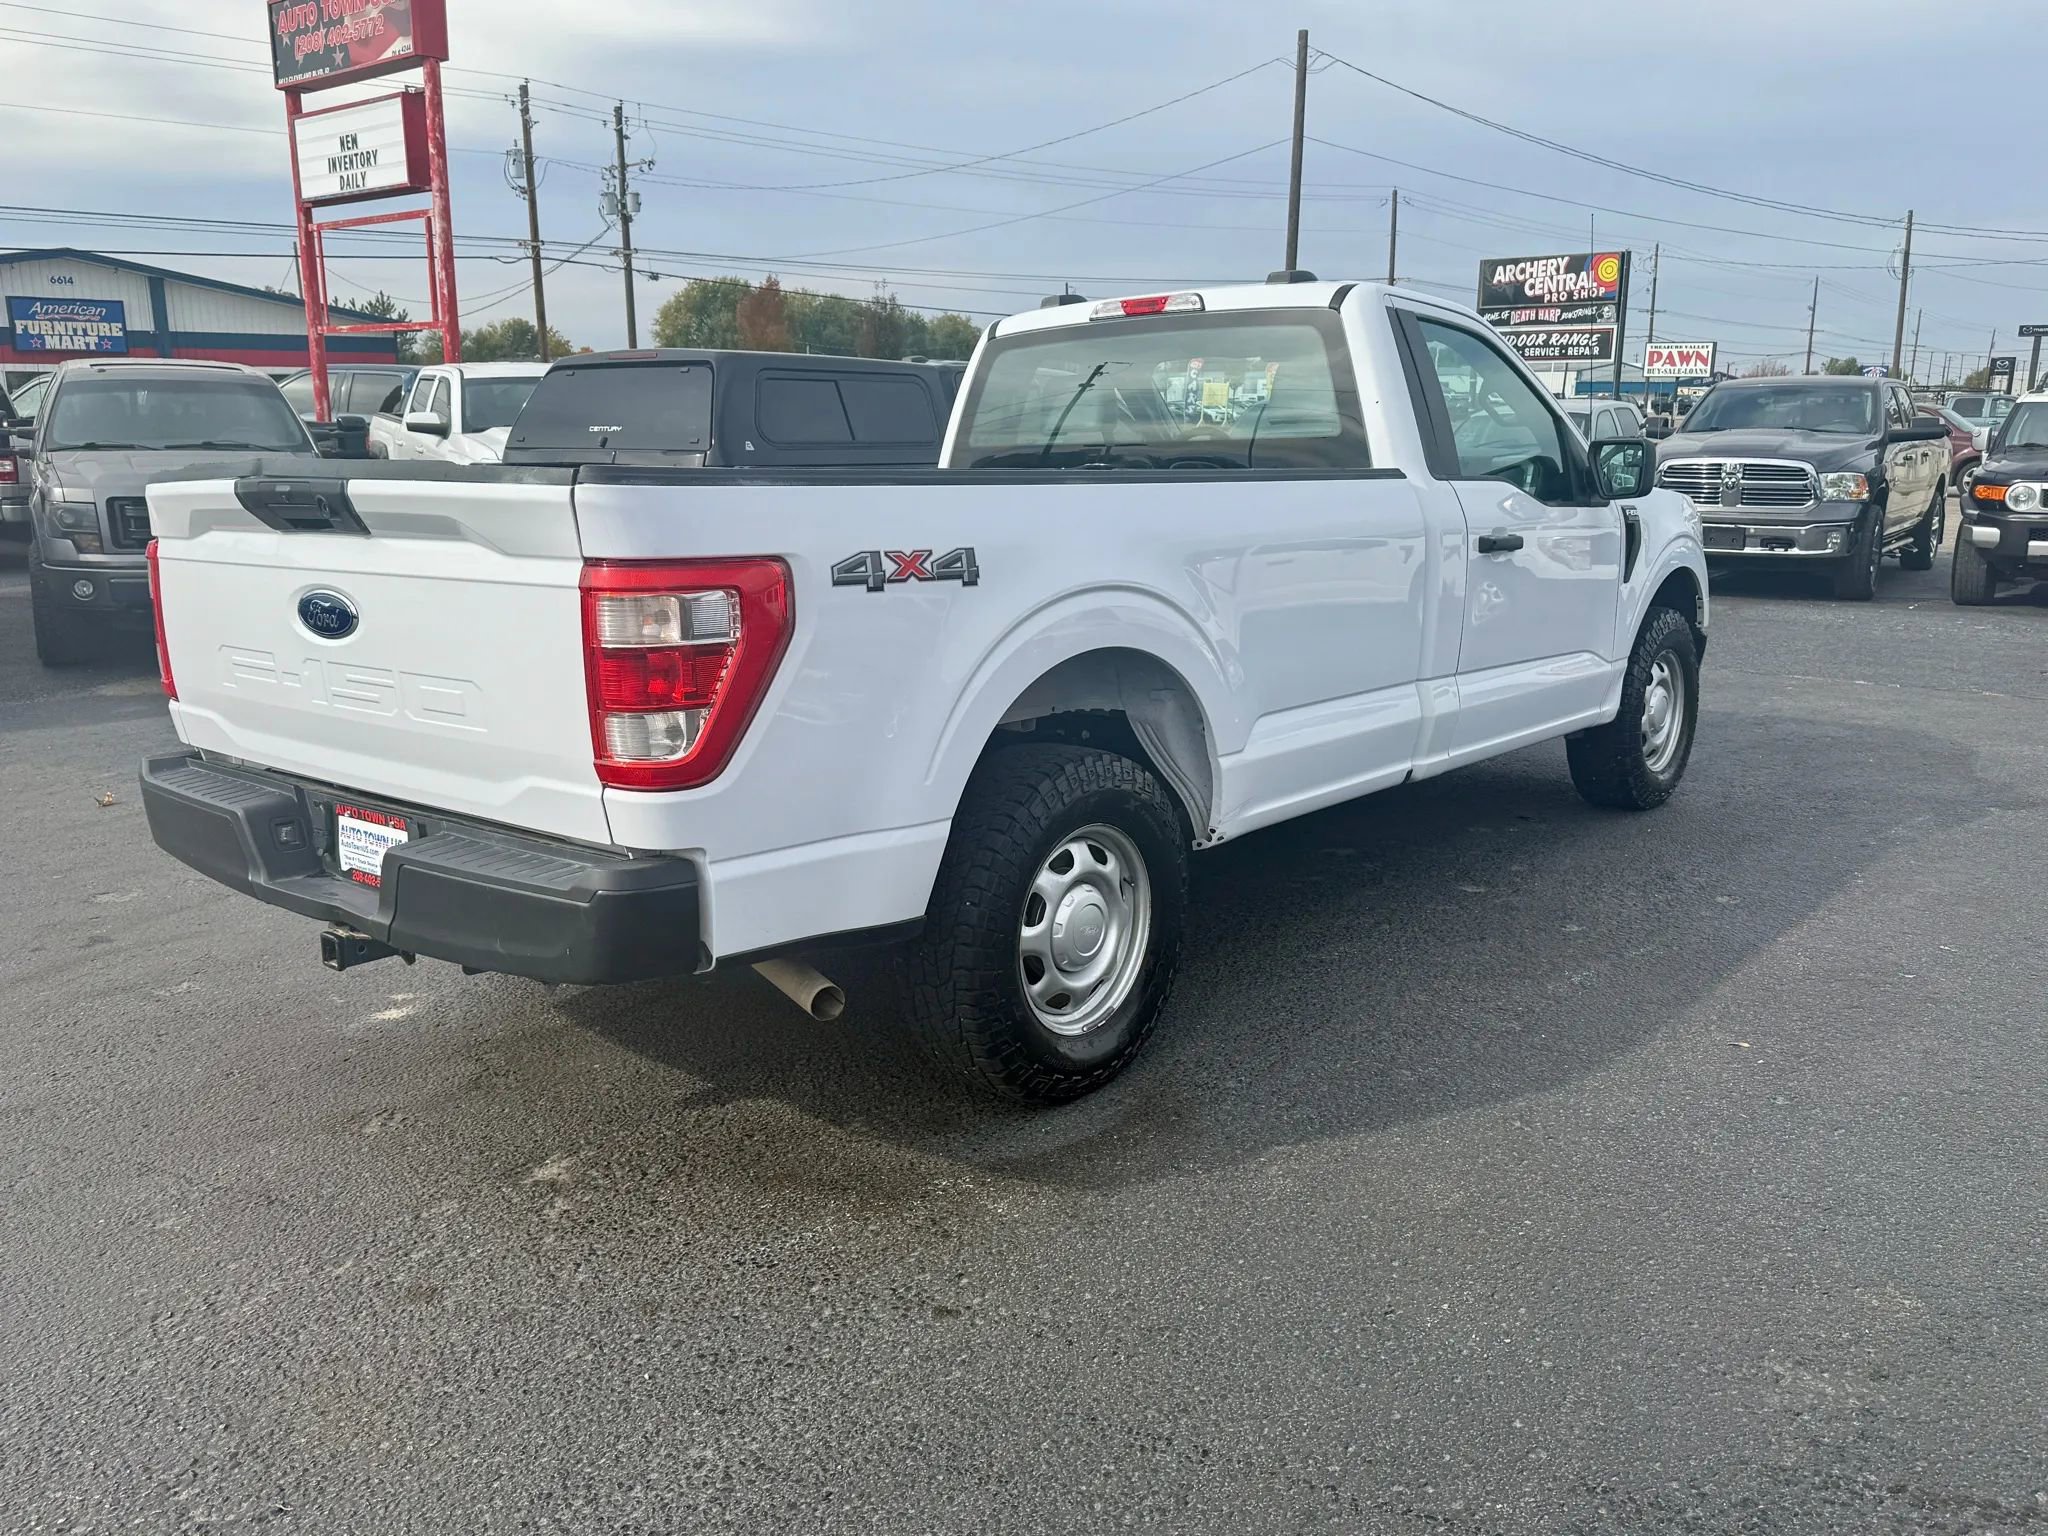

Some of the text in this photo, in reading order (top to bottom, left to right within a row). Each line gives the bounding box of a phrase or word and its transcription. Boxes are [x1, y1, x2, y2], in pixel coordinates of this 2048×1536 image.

[277, 1, 318, 35] AUTO
[294, 13, 384, 61] (208) 402-5772
[339, 133, 358, 152] NEW
[328, 149, 378, 174] INVENTORY
[339, 171, 367, 191] DAILY
[1493, 256, 1570, 286] ARCHERY
[50, 276, 74, 285] 6614
[1524, 271, 1597, 297] CENTRAL
[1544, 287, 1606, 303] PRO SHOP
[28, 302, 106, 316] American
[1500, 310, 1511, 319] OF
[1510, 308, 1536, 325] DEATH
[1538, 308, 1561, 322] HARP
[15, 319, 123, 337] FURNITURE
[44, 335, 99, 350] MART
[1502, 332, 1601, 347] DOOR RANGE
[1524, 346, 1600, 357] SERVICE REPAR
[1647, 350, 1710, 367] PAWN
[307, 599, 339, 629] Ford
[336, 804, 406, 831] AUTO TOWN USA
